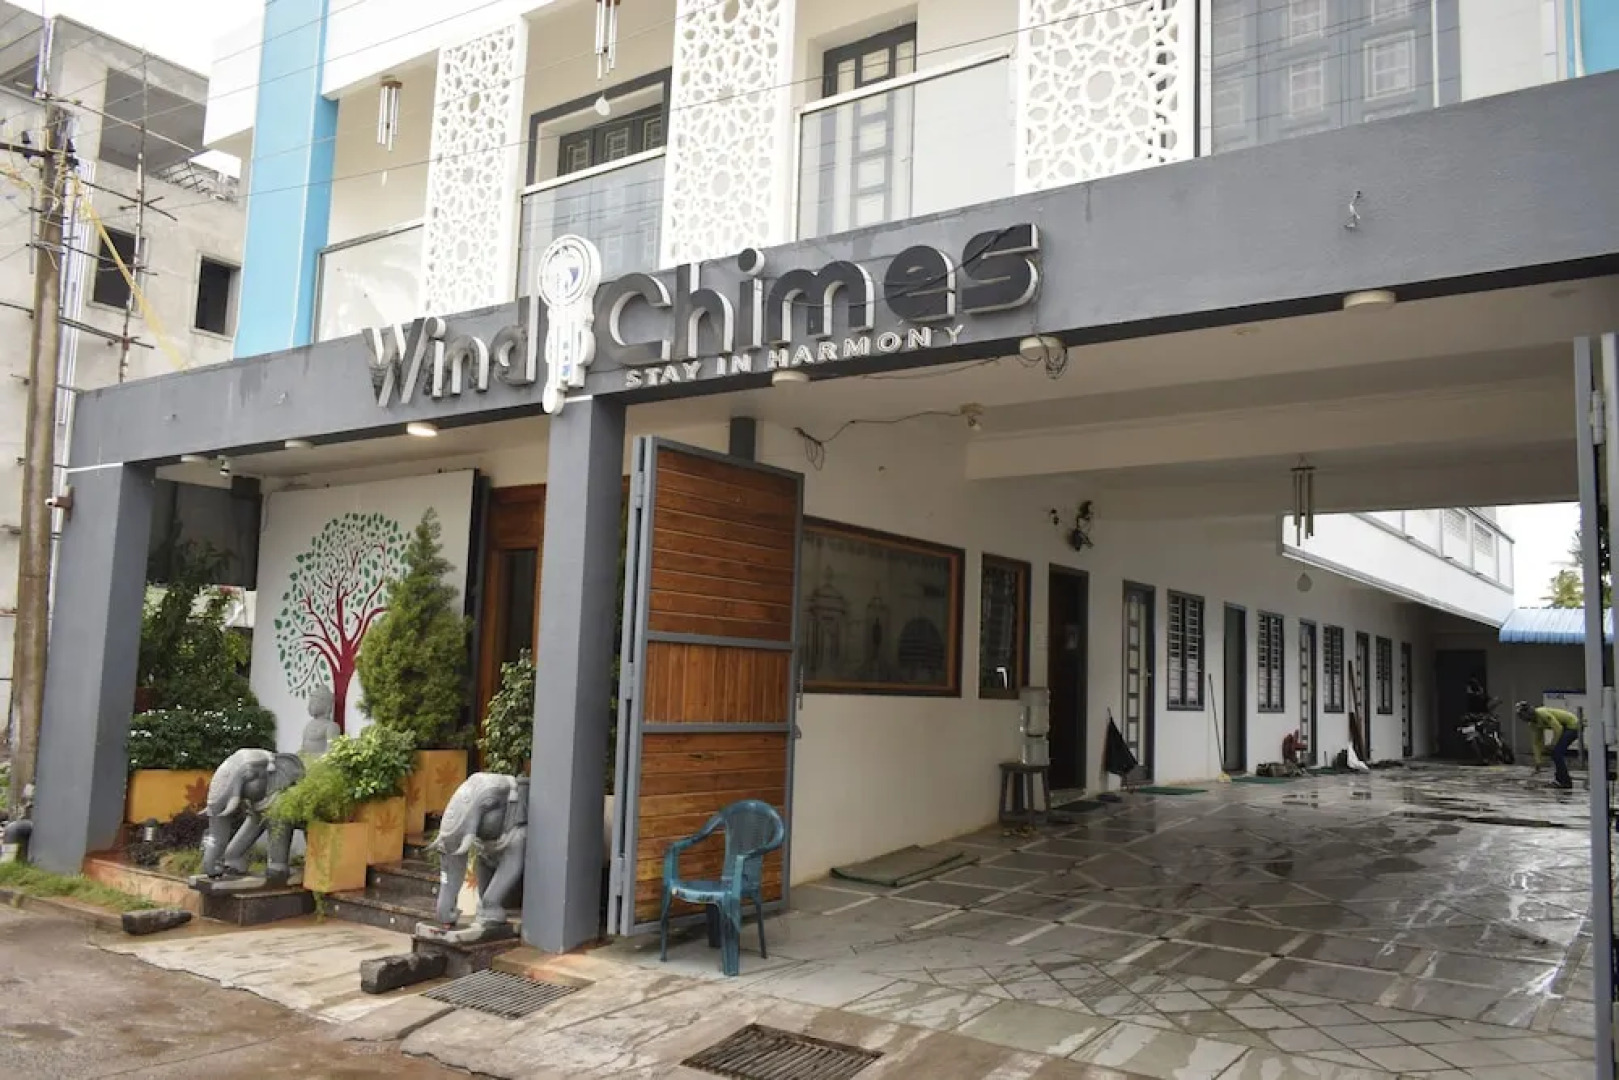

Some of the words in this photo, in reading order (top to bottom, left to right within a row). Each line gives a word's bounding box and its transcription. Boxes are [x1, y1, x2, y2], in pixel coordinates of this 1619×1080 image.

[362, 298, 540, 408] Wind
[593, 223, 1038, 368] Chimes
[625, 360, 701, 388] STAY
[716, 353, 752, 376] IN
[767, 324, 964, 369] HARMONY
